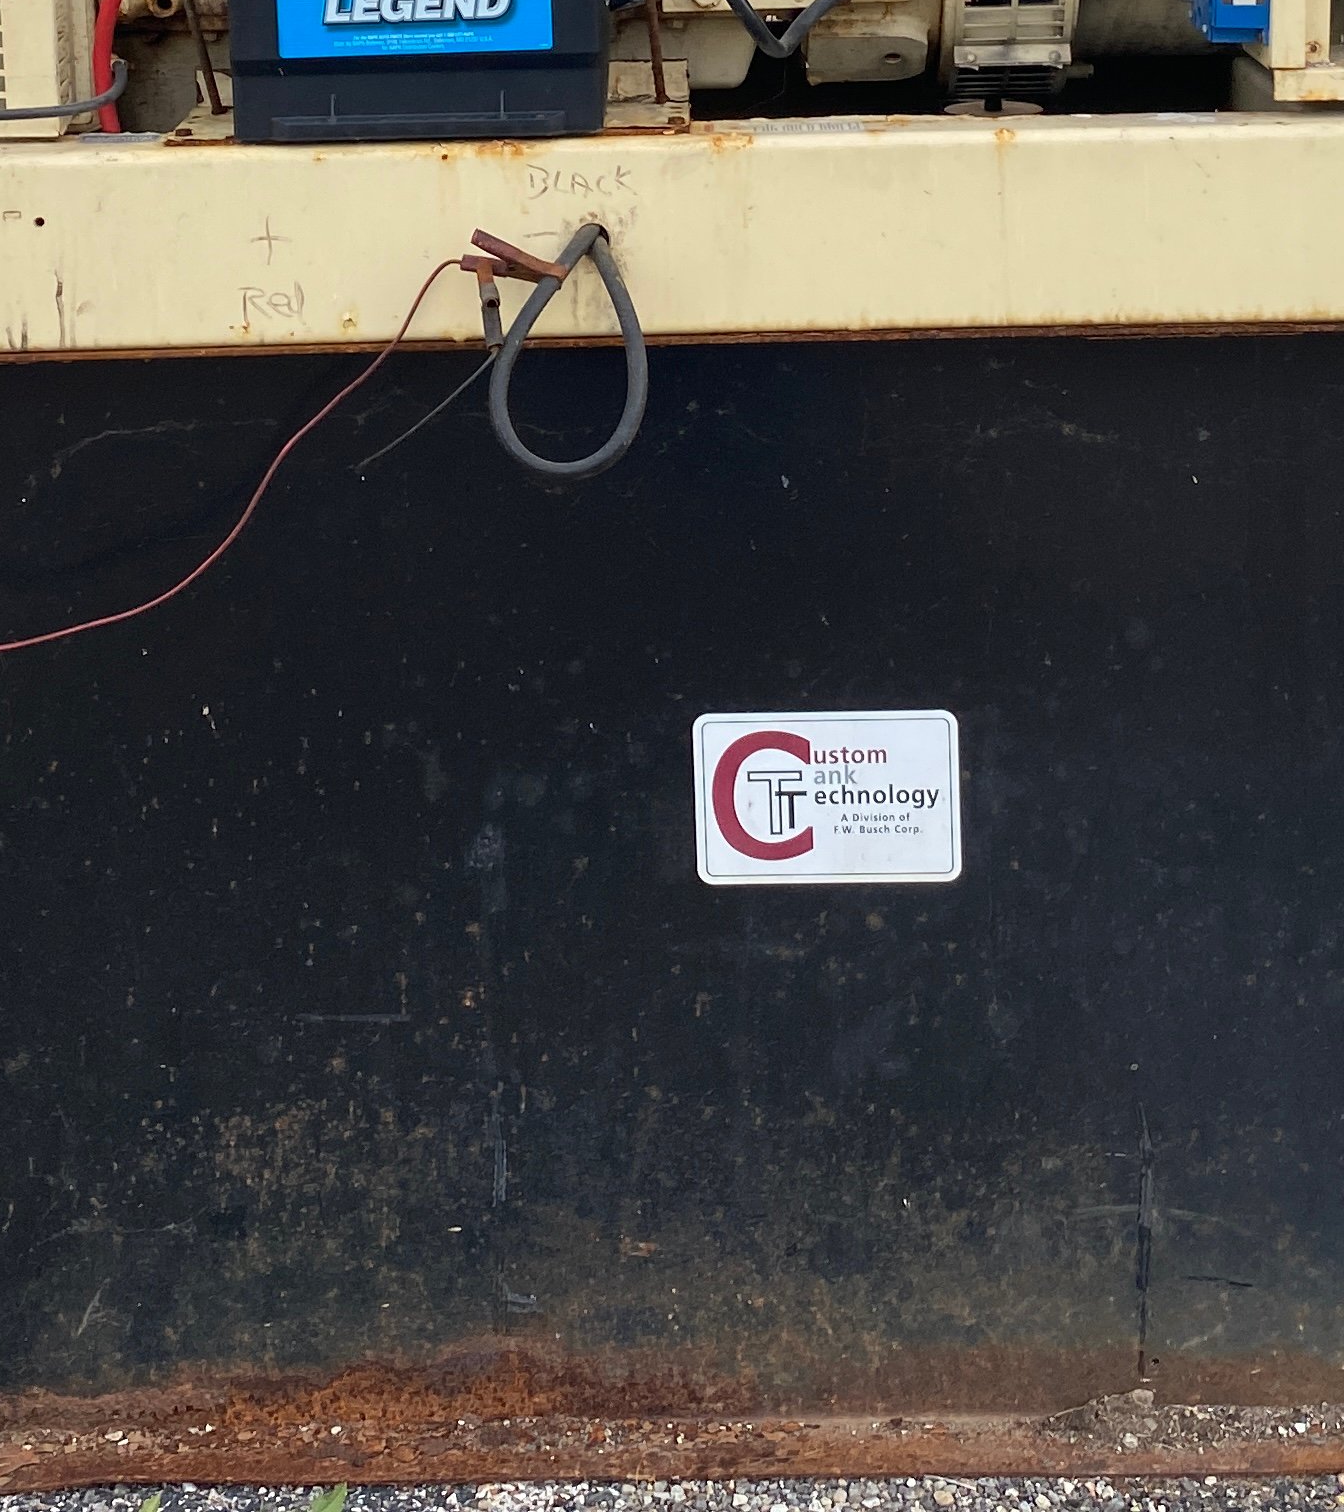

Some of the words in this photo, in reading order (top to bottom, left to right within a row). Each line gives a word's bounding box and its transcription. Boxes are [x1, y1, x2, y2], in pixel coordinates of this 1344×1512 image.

[525, 164, 638, 200] BLACK
[840, 813, 849, 822] A
[852, 813, 896, 822] Division
[899, 812, 911, 821] of
[859, 825, 891, 834] Busch
[894, 825, 924, 835] Corp.
